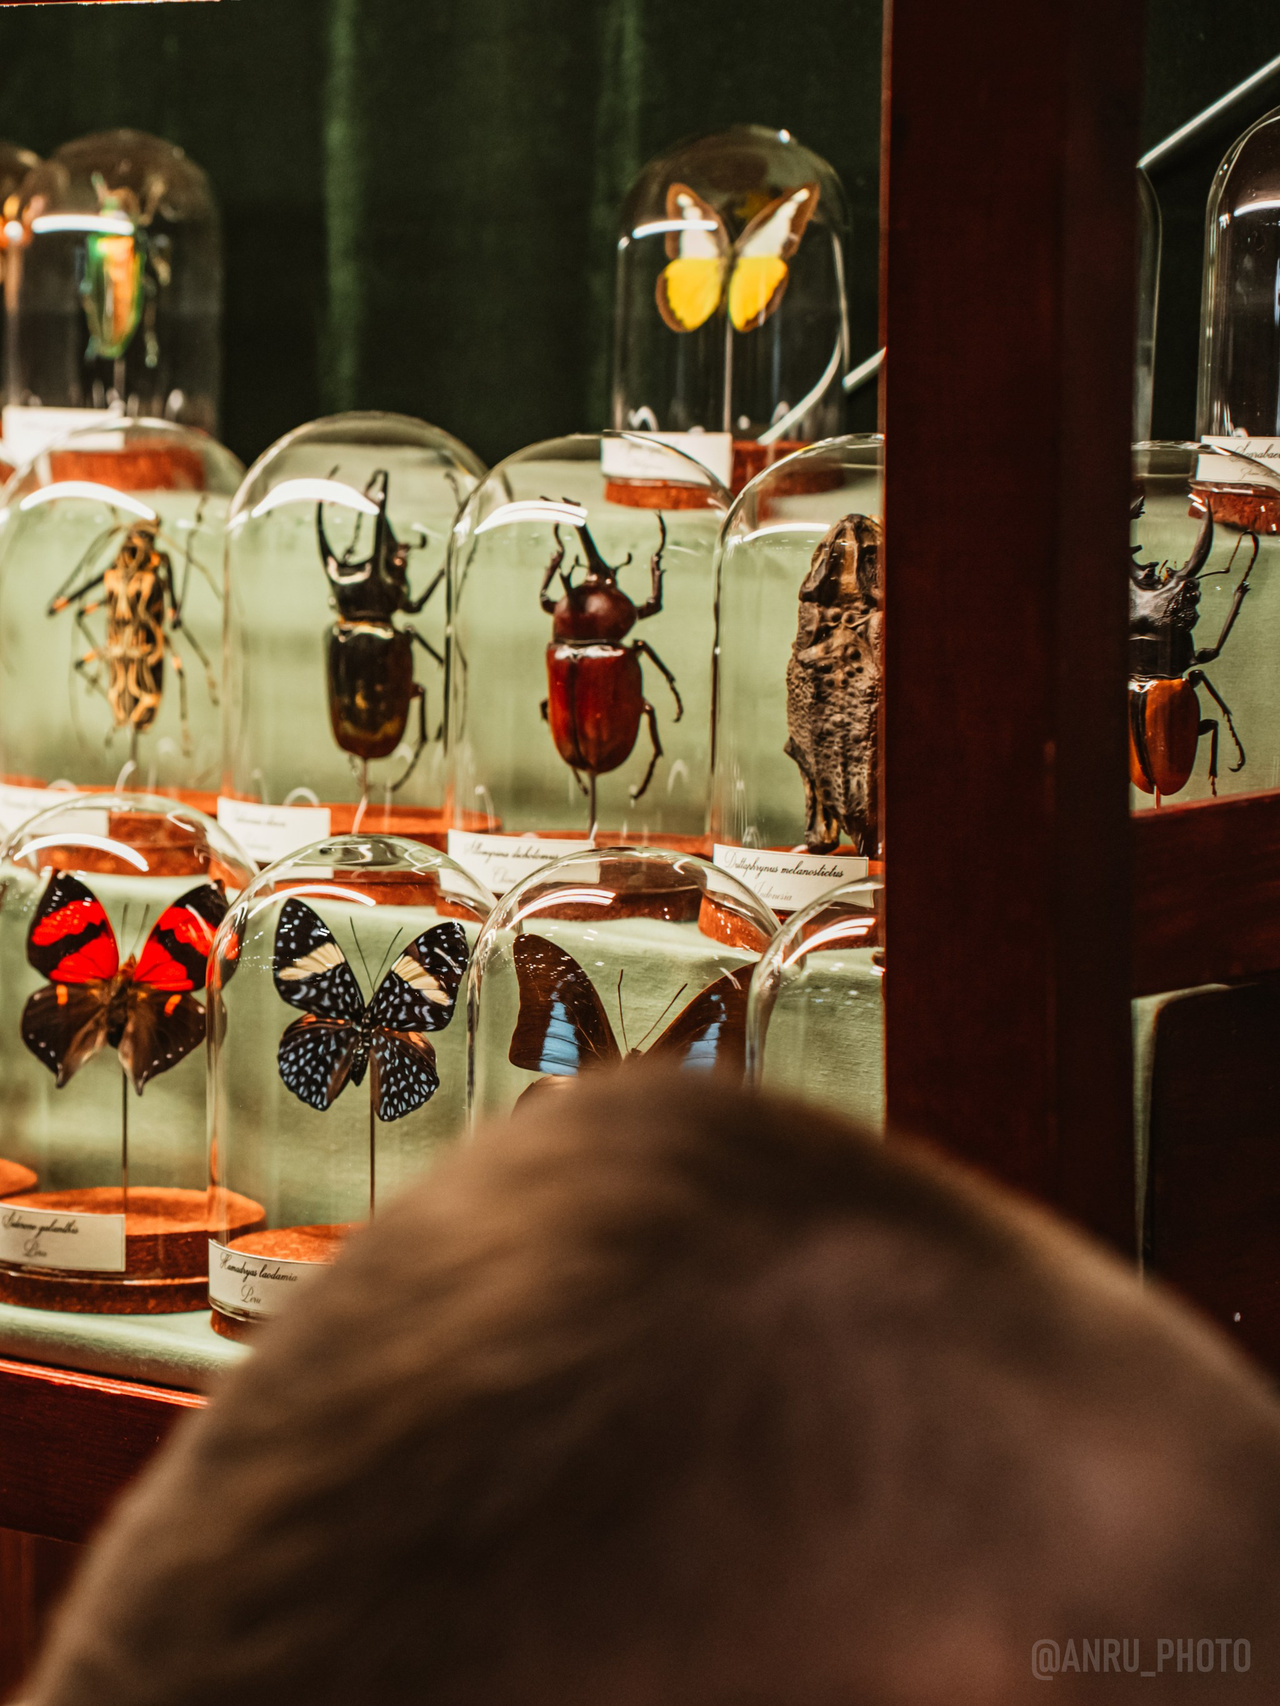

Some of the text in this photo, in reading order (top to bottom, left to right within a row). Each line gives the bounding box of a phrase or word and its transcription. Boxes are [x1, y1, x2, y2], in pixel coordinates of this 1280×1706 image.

[780, 861, 844, 879] melanostictus
[753, 880, 793, 901] Indonesia
[220, 1251, 298, 1283] Hamadryas laodamia
[241, 1284, 262, 1304] Peru
